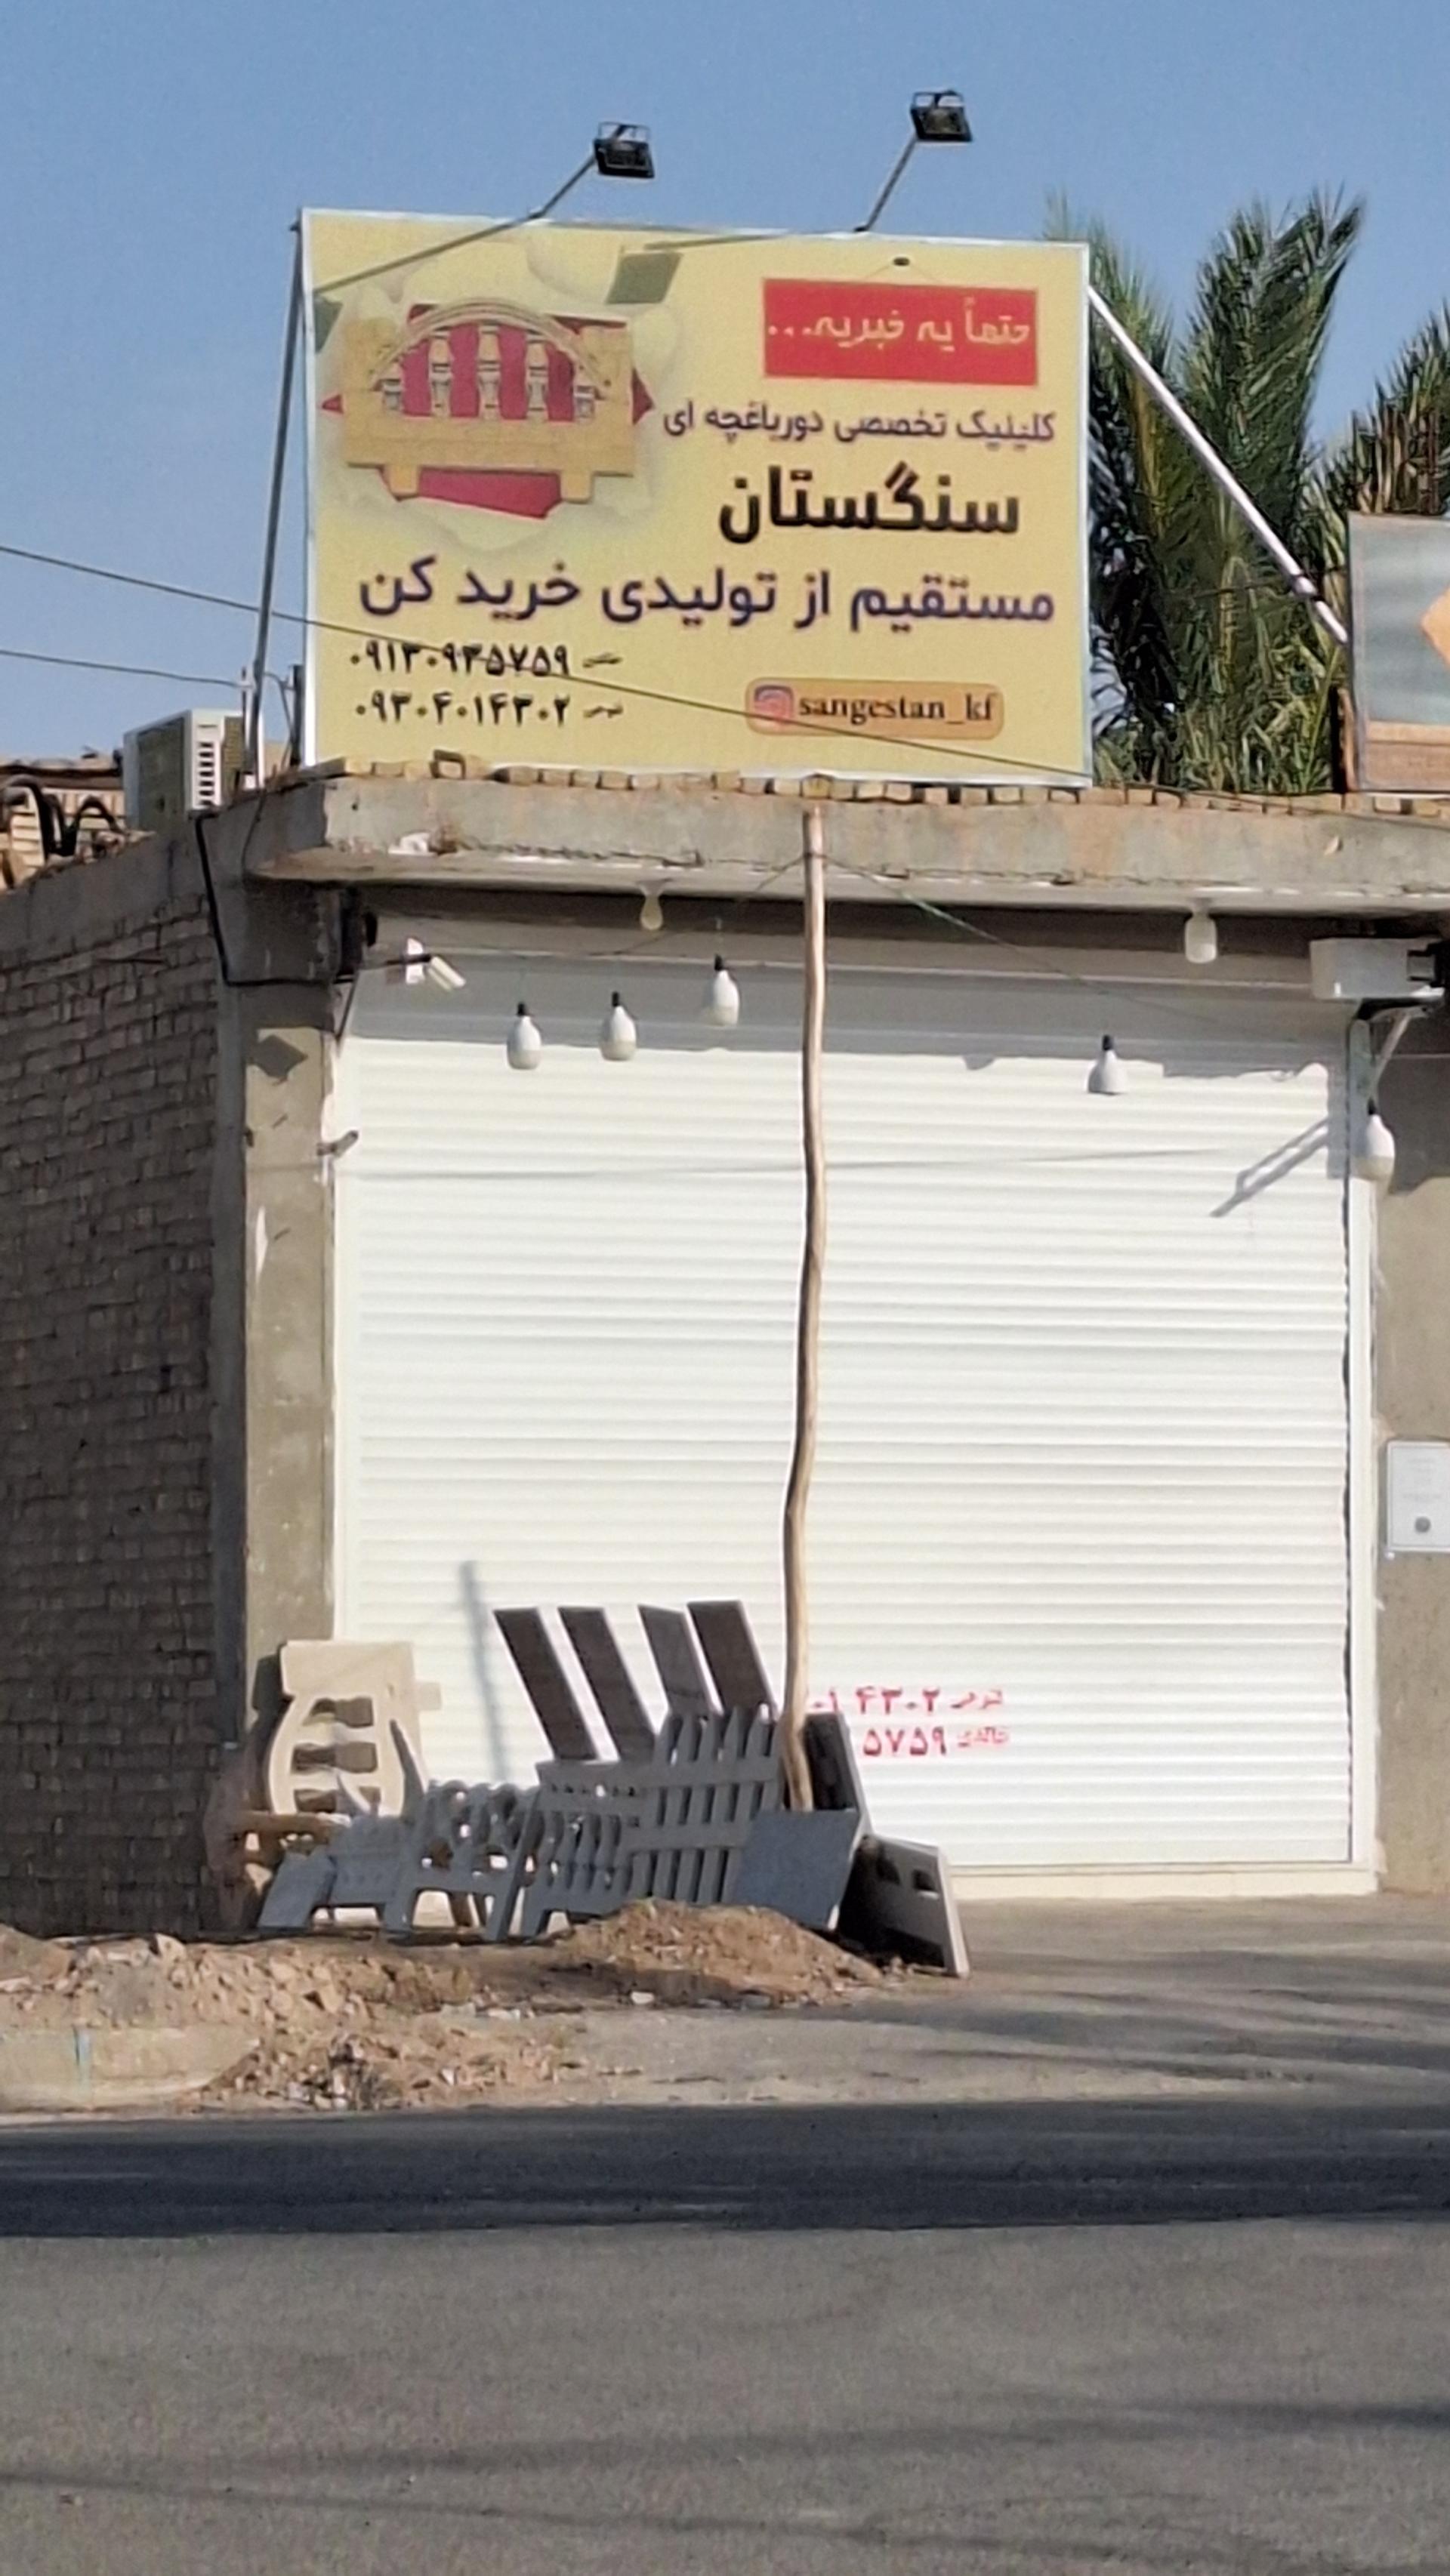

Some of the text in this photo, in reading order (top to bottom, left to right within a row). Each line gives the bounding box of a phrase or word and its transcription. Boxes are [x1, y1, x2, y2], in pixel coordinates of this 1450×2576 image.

[917, 321, 955, 353] یه
[834, 410, 948, 445] تخصصی
[956, 411, 1057, 451] کلینیک
[718, 461, 1021, 546] سنگستان
[359, 556, 1056, 633] مستقیم از تولیدی خرید کن
[355, 690, 572, 726] ۰۹۳۰۴۰۱۴۳۰۲
[798, 693, 998, 726] sangestan_kf
